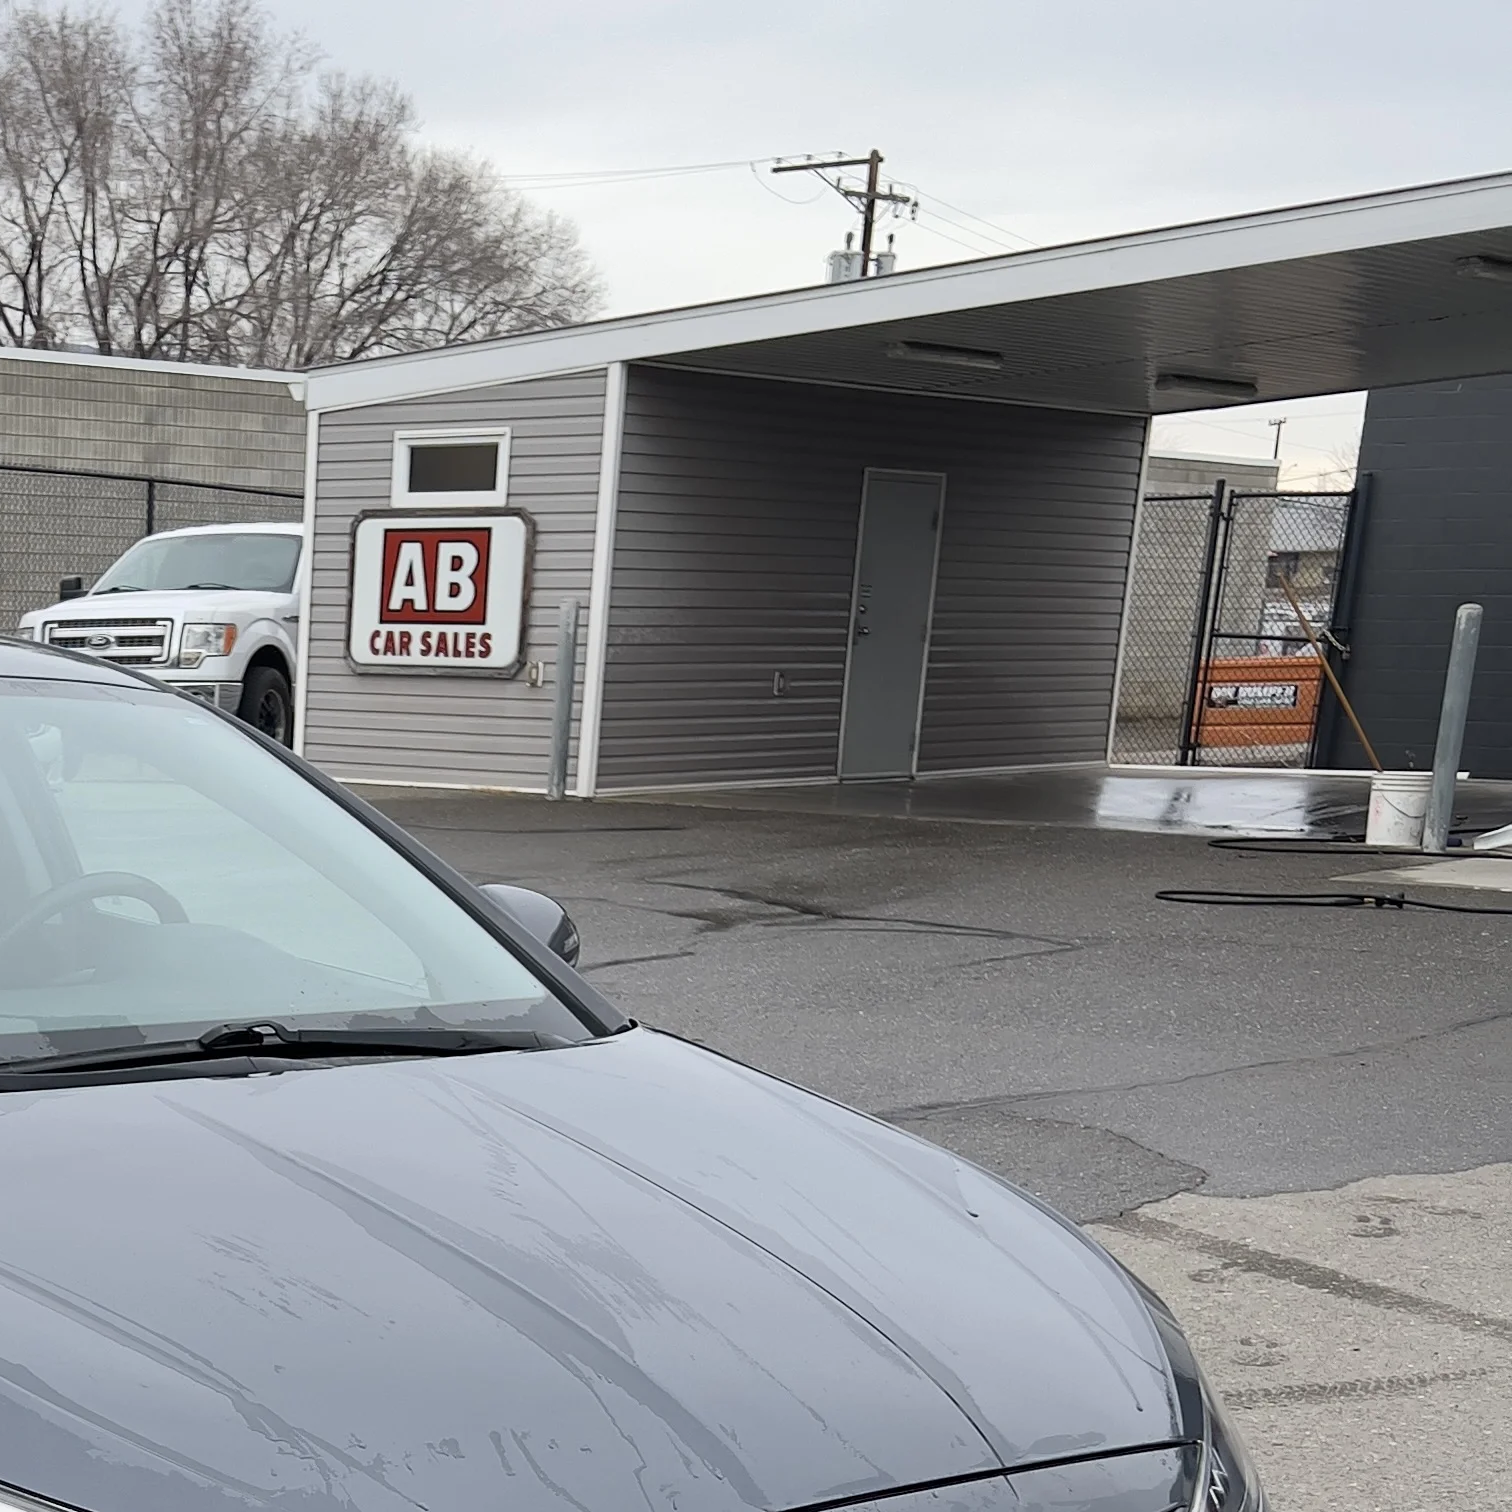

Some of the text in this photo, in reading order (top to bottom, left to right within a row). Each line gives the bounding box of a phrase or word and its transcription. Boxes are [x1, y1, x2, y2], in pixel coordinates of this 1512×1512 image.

[388, 540, 479, 612] AB
[369, 630, 492, 658] CAR SALES
